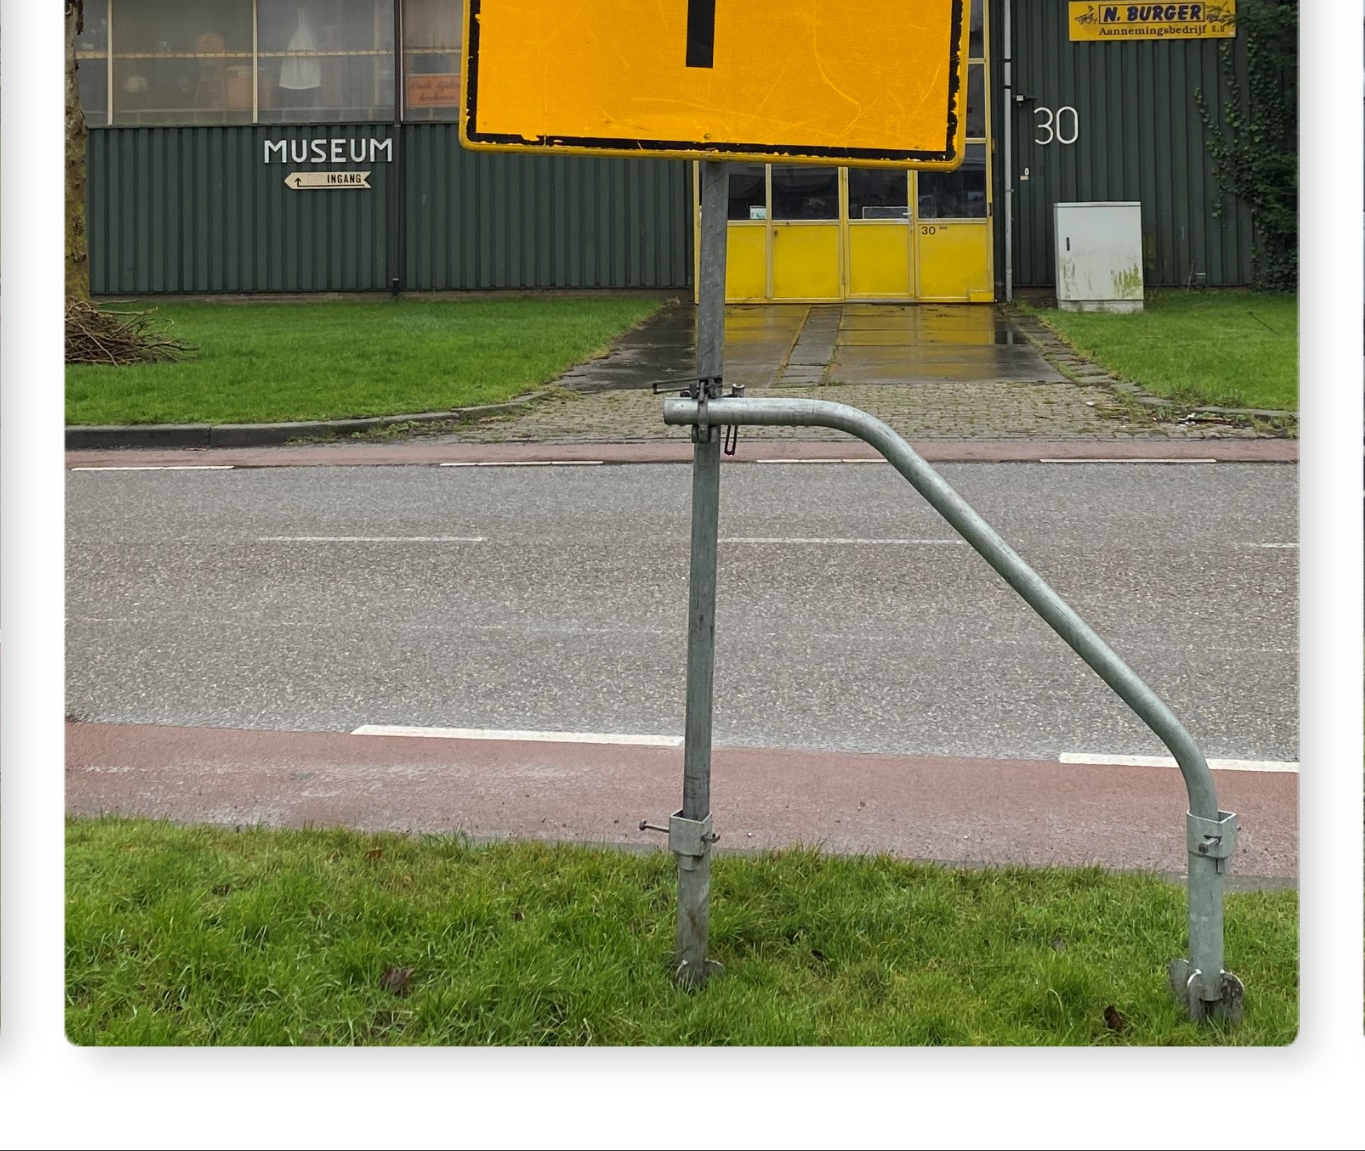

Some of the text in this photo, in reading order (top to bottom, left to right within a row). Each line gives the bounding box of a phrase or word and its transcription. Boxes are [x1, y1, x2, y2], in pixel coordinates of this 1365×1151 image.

[1103, 4, 1202, 23] N. BURGER
[1099, 24, 1207, 36] Aannemingsbedrijf
[1033, 106, 1079, 145] 30
[264, 138, 393, 163] MUSEUM
[327, 174, 362, 184] INGANG
[921, 226, 936, 235] 30
